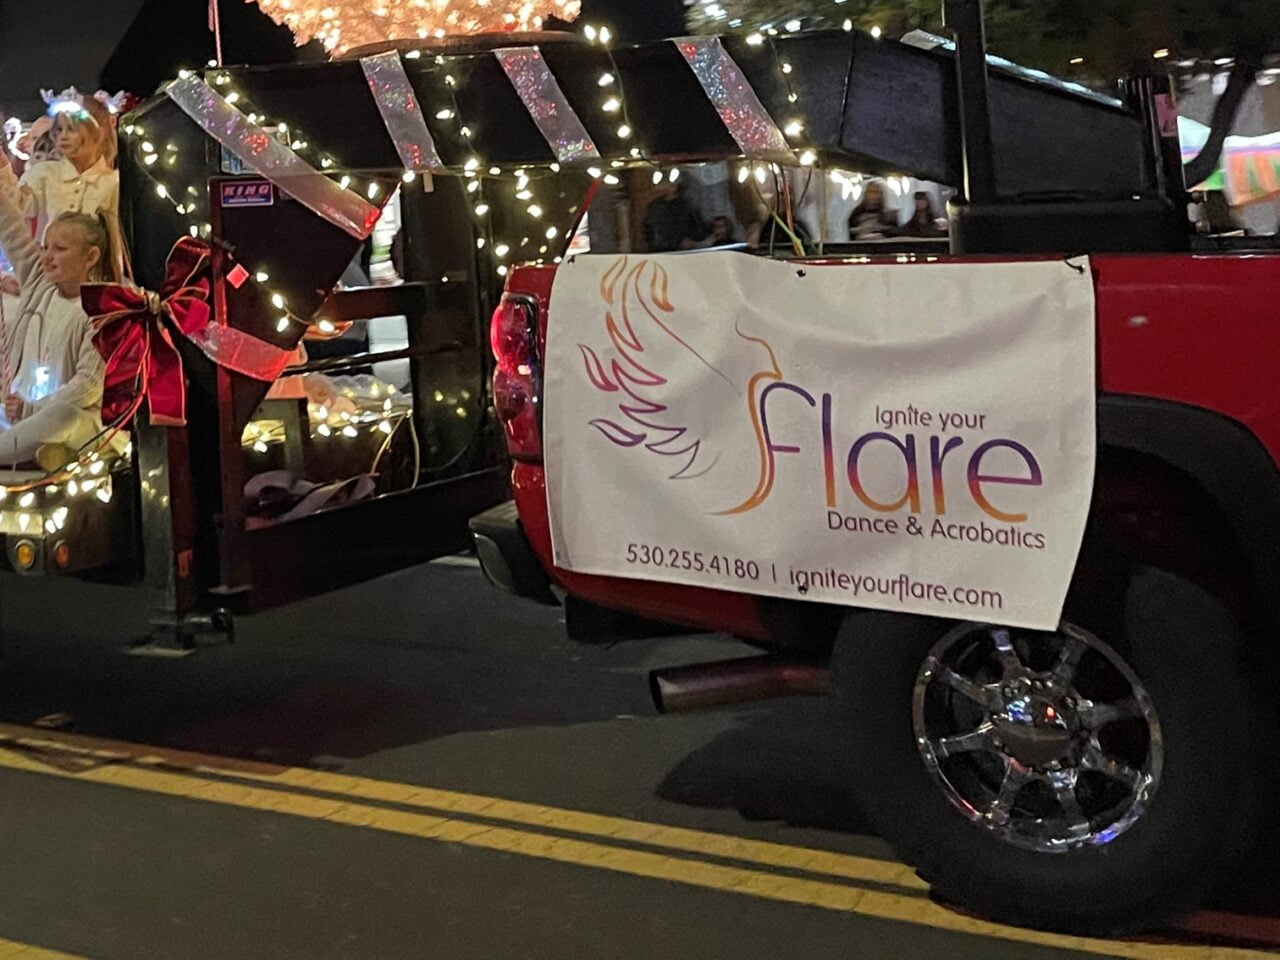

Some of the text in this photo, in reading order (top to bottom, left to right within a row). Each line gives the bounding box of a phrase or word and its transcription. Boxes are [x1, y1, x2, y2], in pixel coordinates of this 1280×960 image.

[875, 404, 987, 432] Ignite your
[720, 381, 1043, 523] flare
[827, 510, 1046, 549] Dance & Acrobatics
[625, 542, 760, 581] 530.255.4180
[789, 565, 1003, 609] igniteyourflare.com
